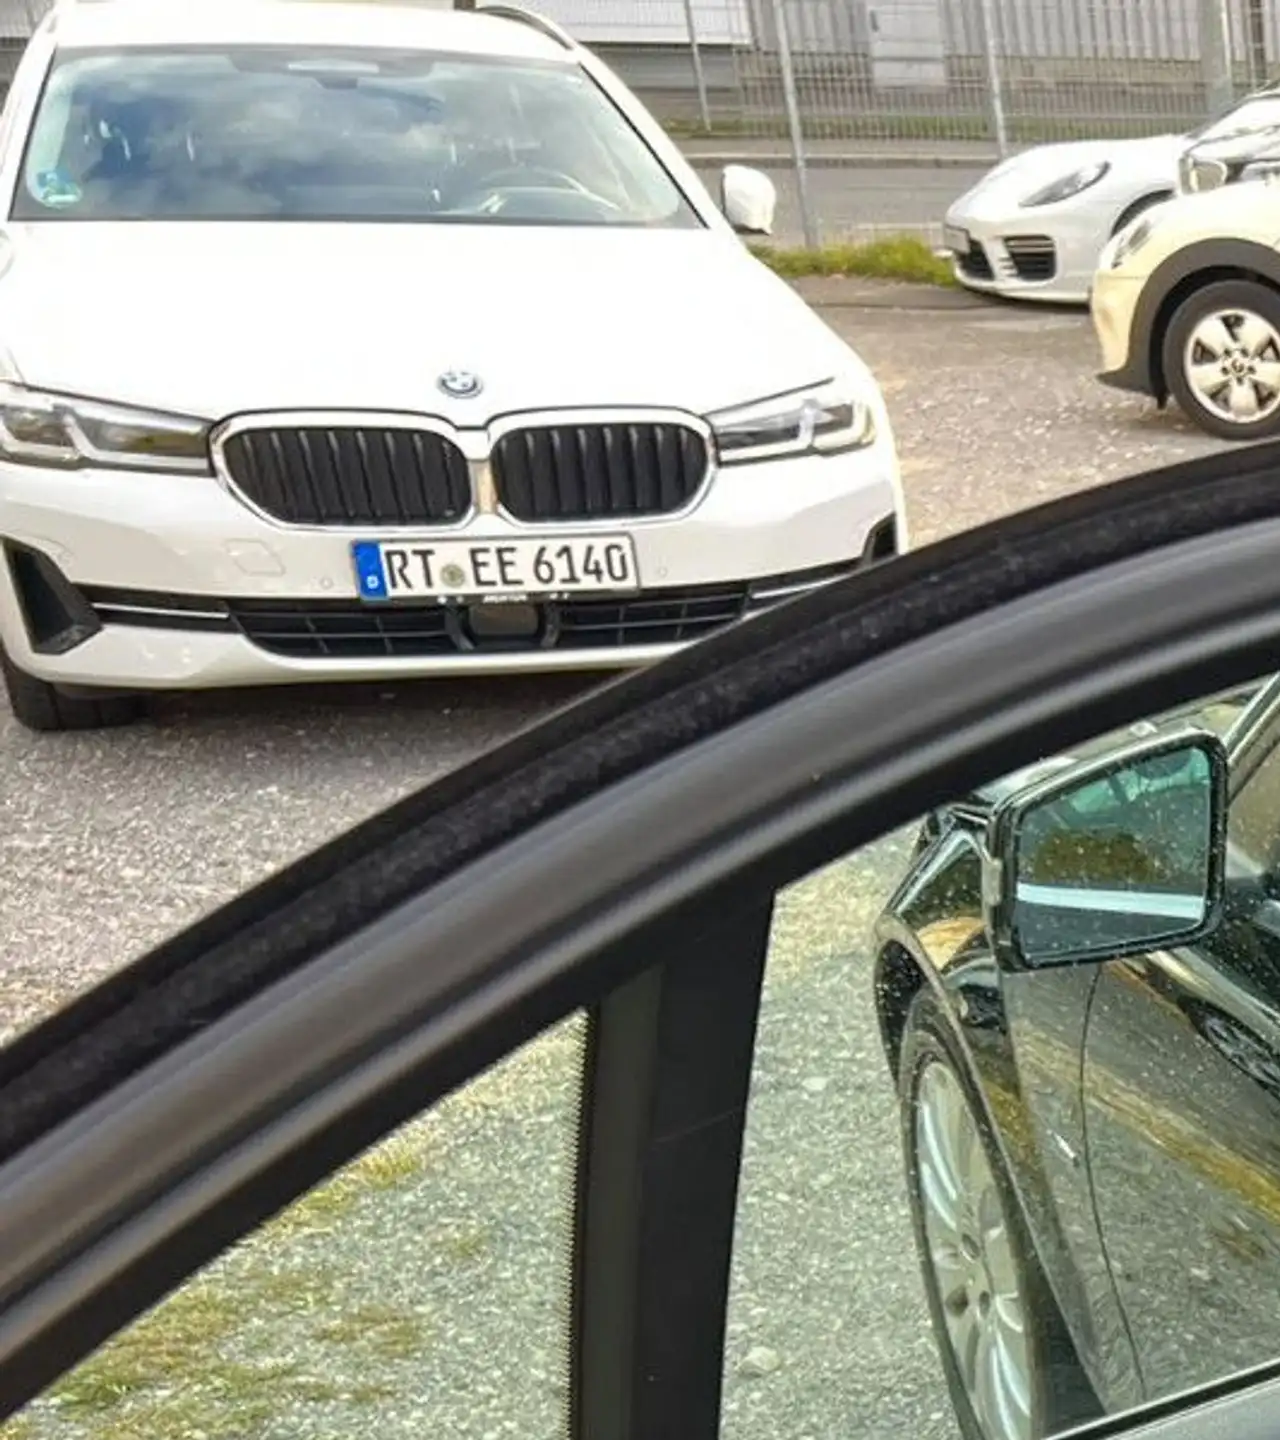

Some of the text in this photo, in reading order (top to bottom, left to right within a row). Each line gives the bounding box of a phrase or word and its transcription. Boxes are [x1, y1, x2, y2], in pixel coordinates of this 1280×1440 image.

[384, 543, 630, 589] RT EE 6140
